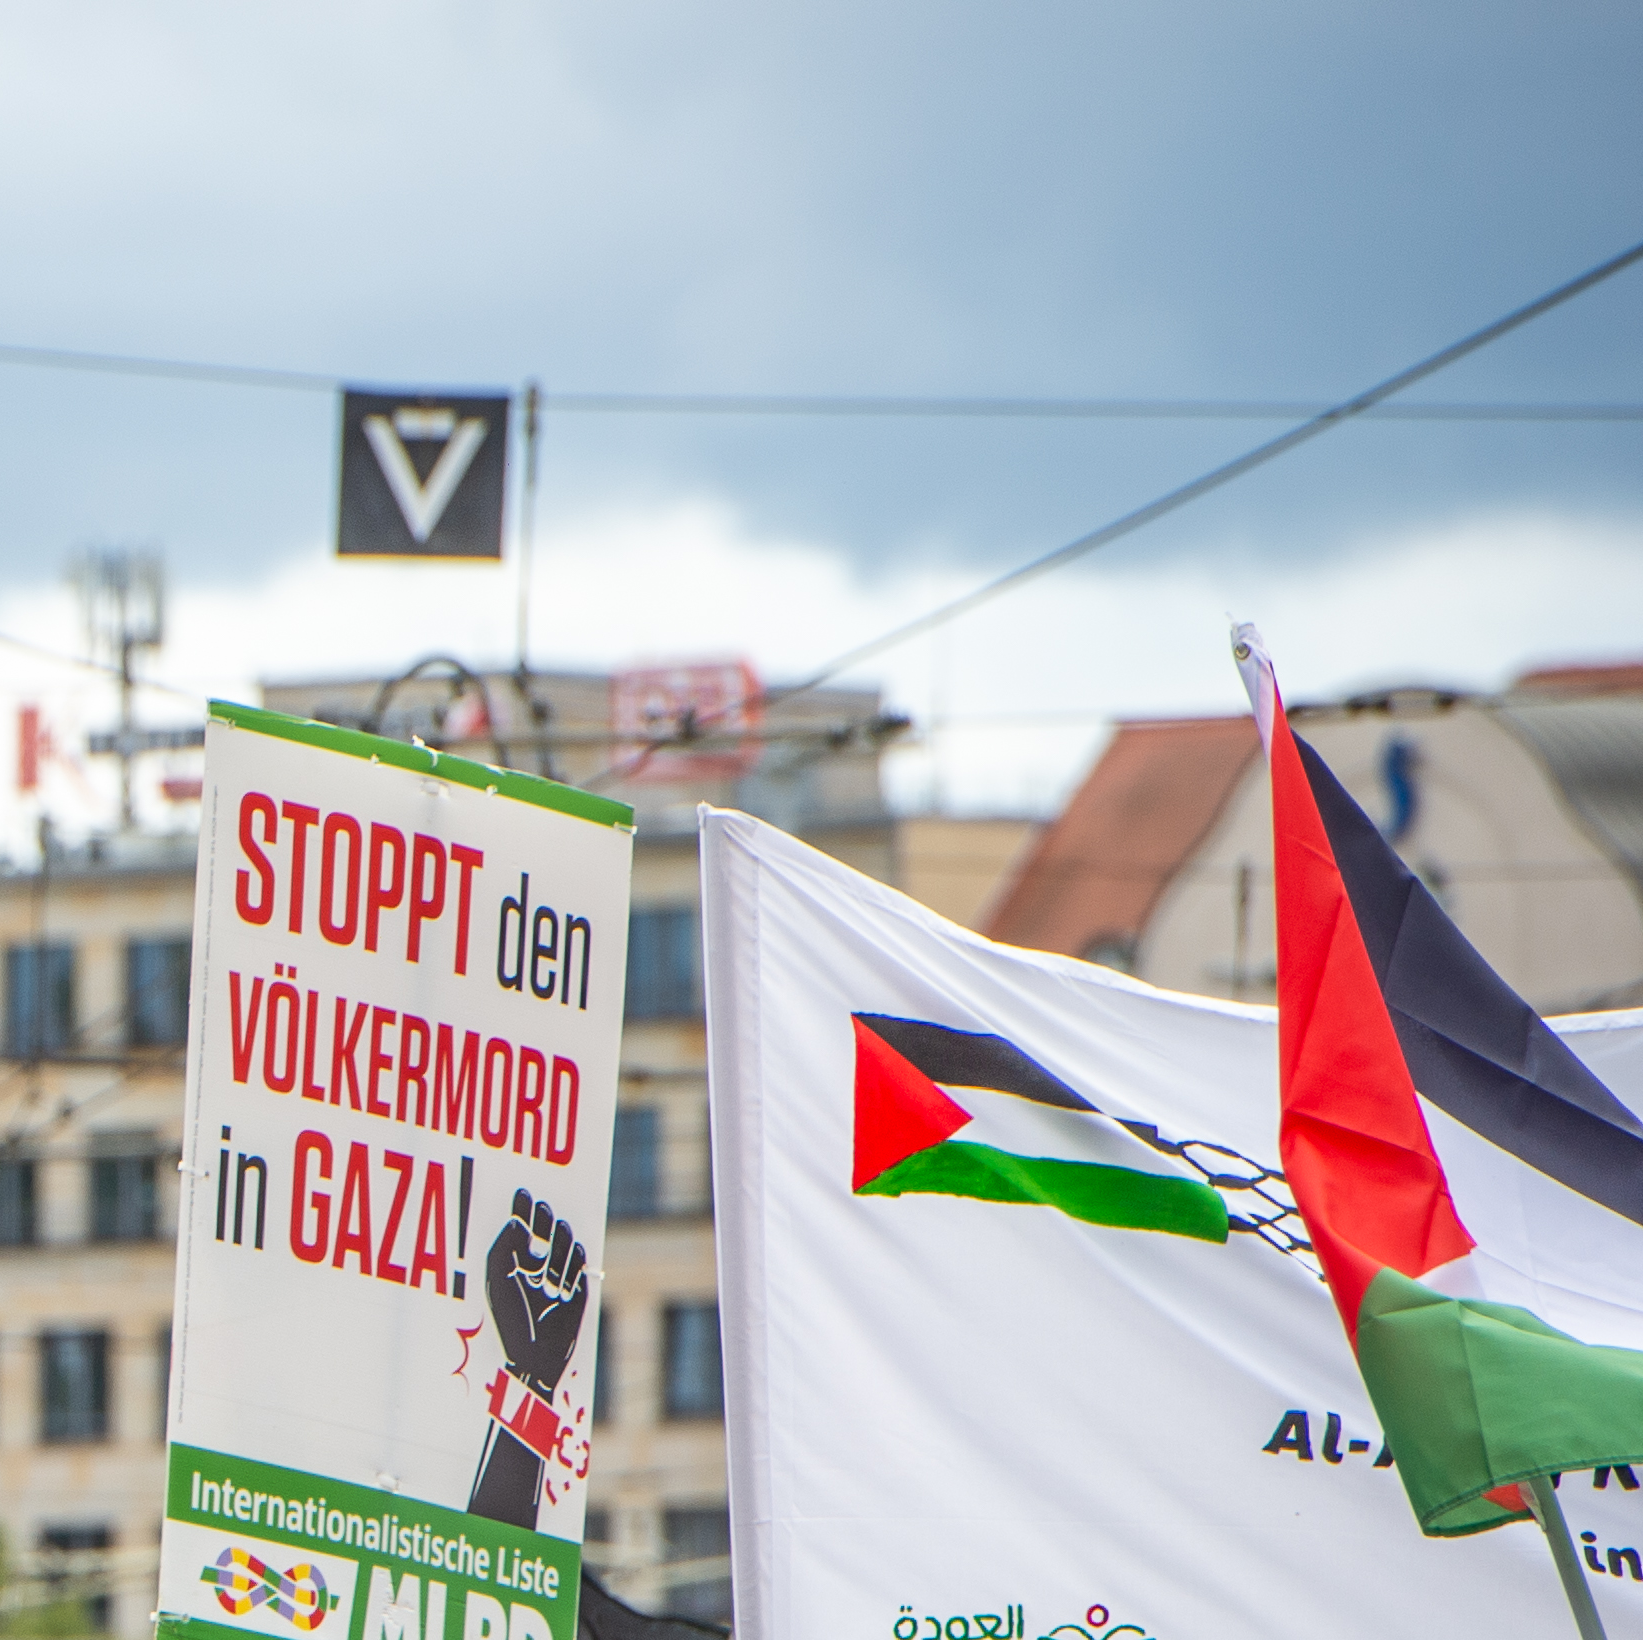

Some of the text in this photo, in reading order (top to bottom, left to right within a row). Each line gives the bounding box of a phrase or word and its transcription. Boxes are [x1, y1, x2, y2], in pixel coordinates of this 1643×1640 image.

[234, 791, 592, 1011] STOPPT den
[228, 962, 581, 1166] VÖLKERMORD
[215, 1124, 475, 1301] in GAZA!
[191, 1471, 560, 1600] Internationalistische Liste
